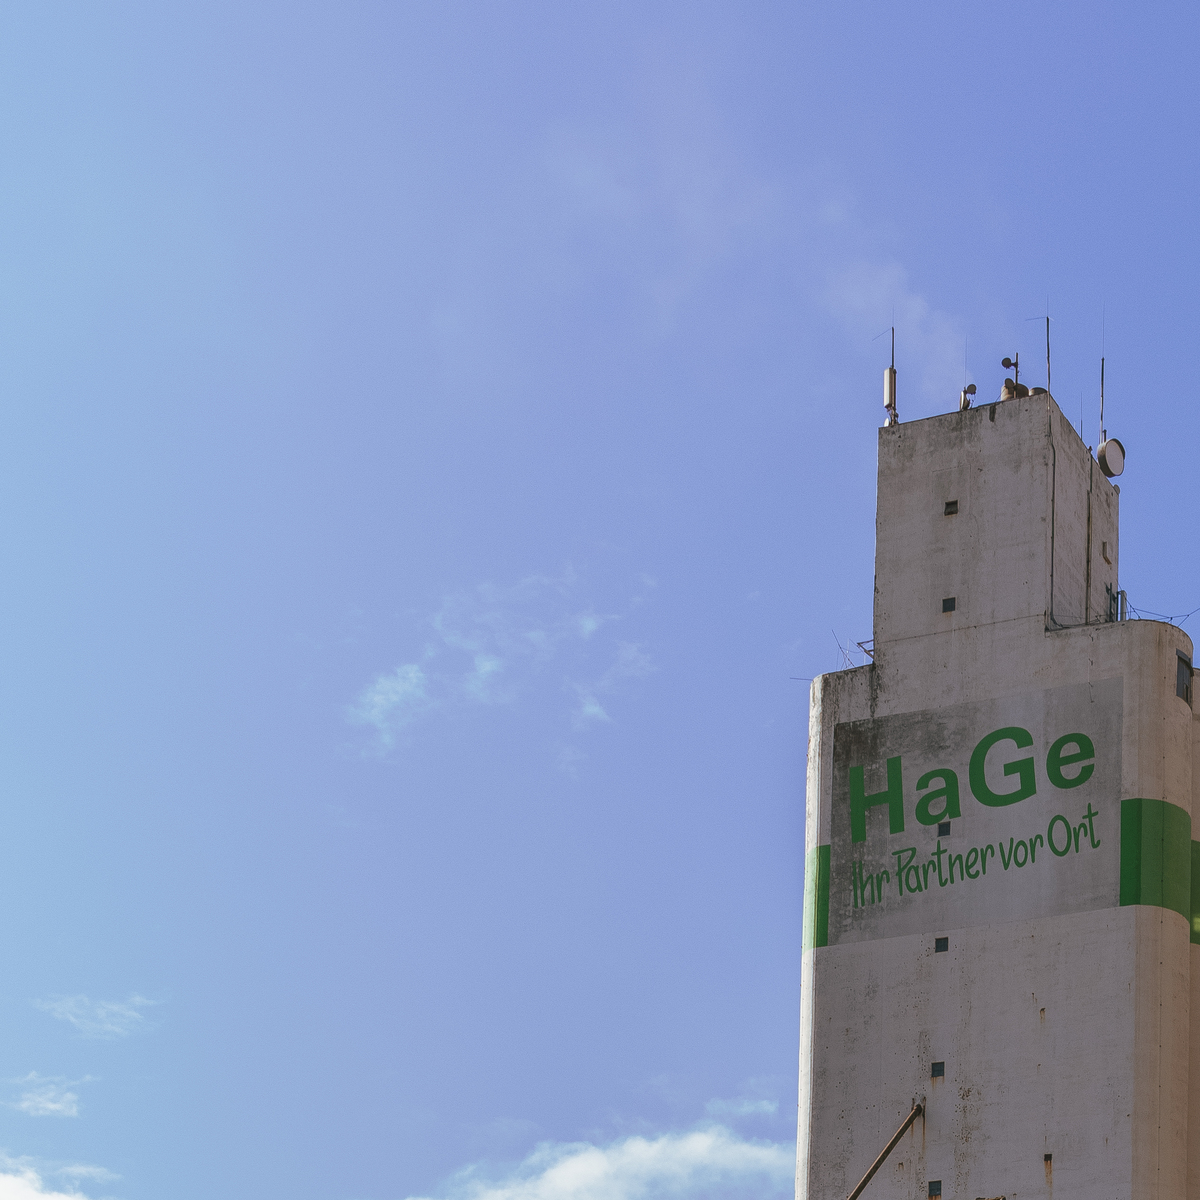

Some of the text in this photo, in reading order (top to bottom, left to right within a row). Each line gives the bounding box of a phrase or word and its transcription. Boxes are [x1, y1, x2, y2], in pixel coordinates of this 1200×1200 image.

[849, 726, 1096, 844] HaGe
[852, 802, 1101, 909] Ihr Partner vor Ort
